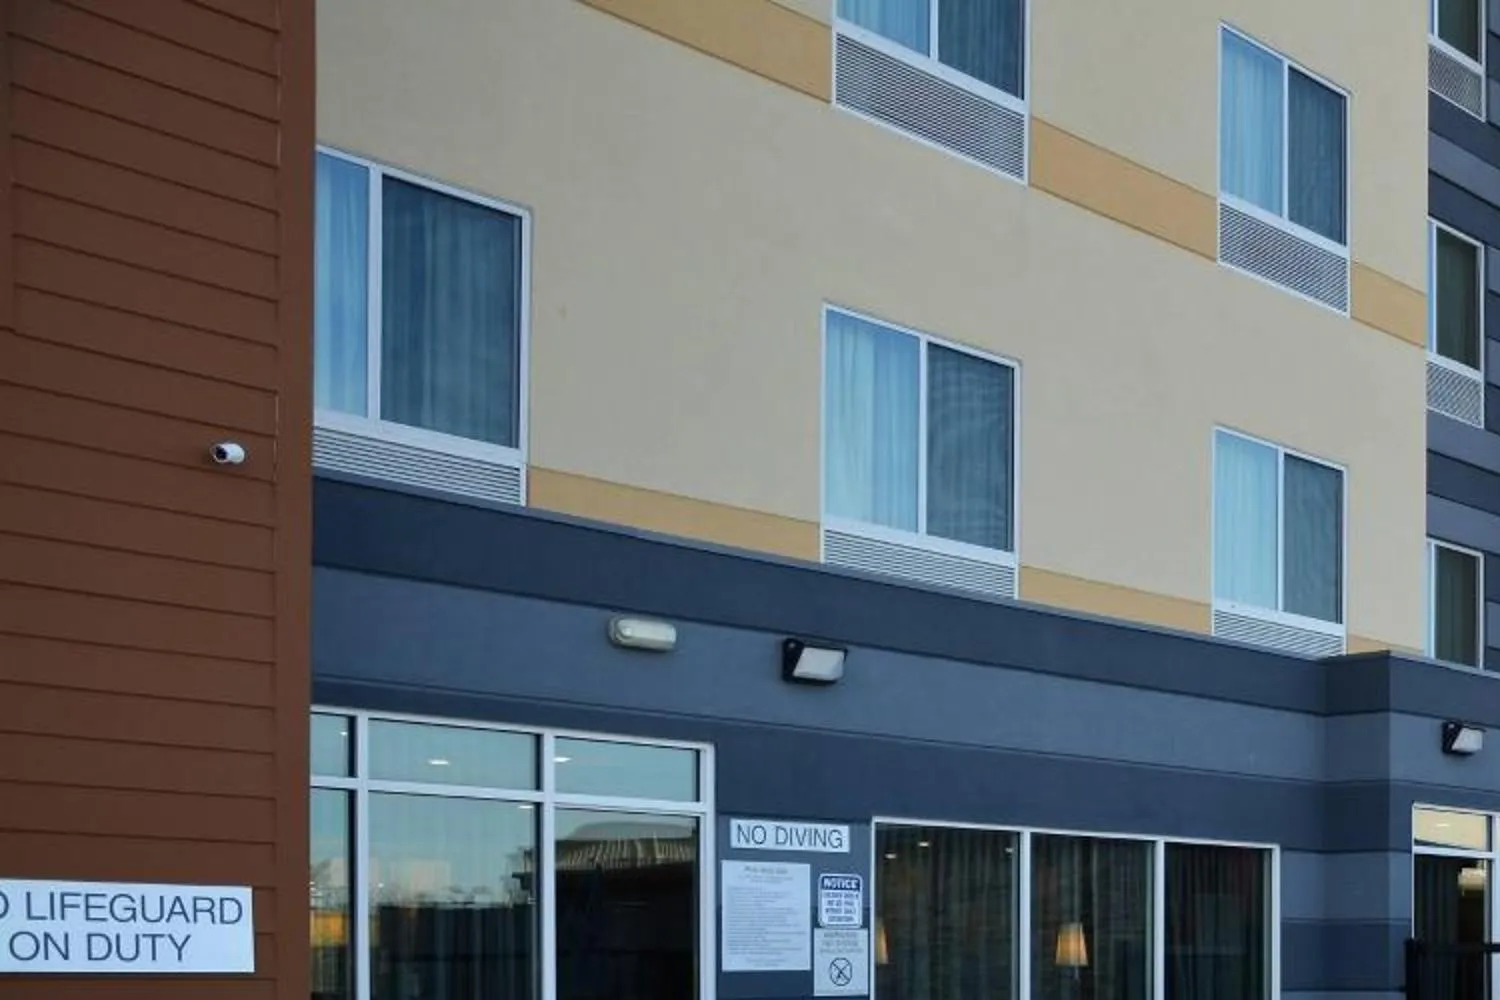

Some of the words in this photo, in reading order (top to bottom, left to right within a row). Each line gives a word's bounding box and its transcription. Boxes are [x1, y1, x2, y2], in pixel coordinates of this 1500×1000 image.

[736, 824, 767, 845] NO
[775, 825, 843, 849] DIVING
[823, 878, 859, 890] NOTICE
[26, 891, 243, 925] LIFEGUARD
[9, 931, 70, 961] ON
[87, 933, 191, 962] DUTY
